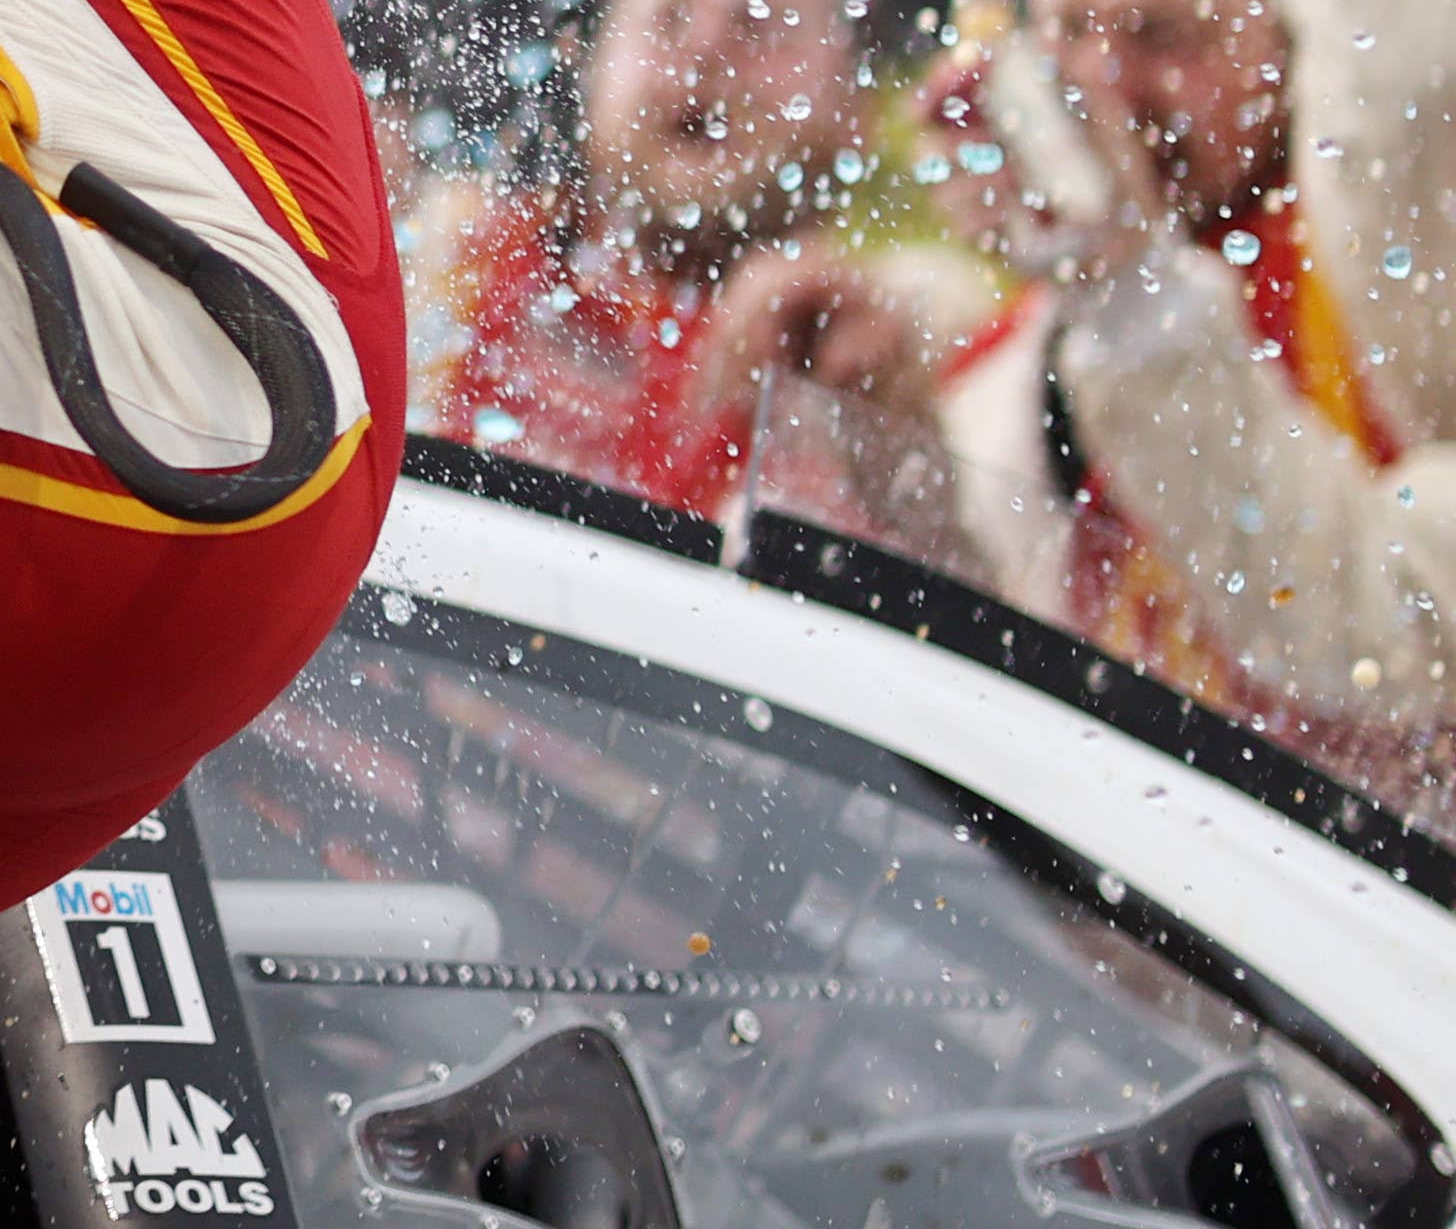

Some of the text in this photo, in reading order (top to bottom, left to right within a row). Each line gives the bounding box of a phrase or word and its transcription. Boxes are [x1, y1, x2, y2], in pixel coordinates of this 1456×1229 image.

[55, 882, 154, 917] Mobil
[96, 927, 150, 1018] 1
[84, 1078, 267, 1179] MAC
[95, 1179, 275, 1218] TOOLS
